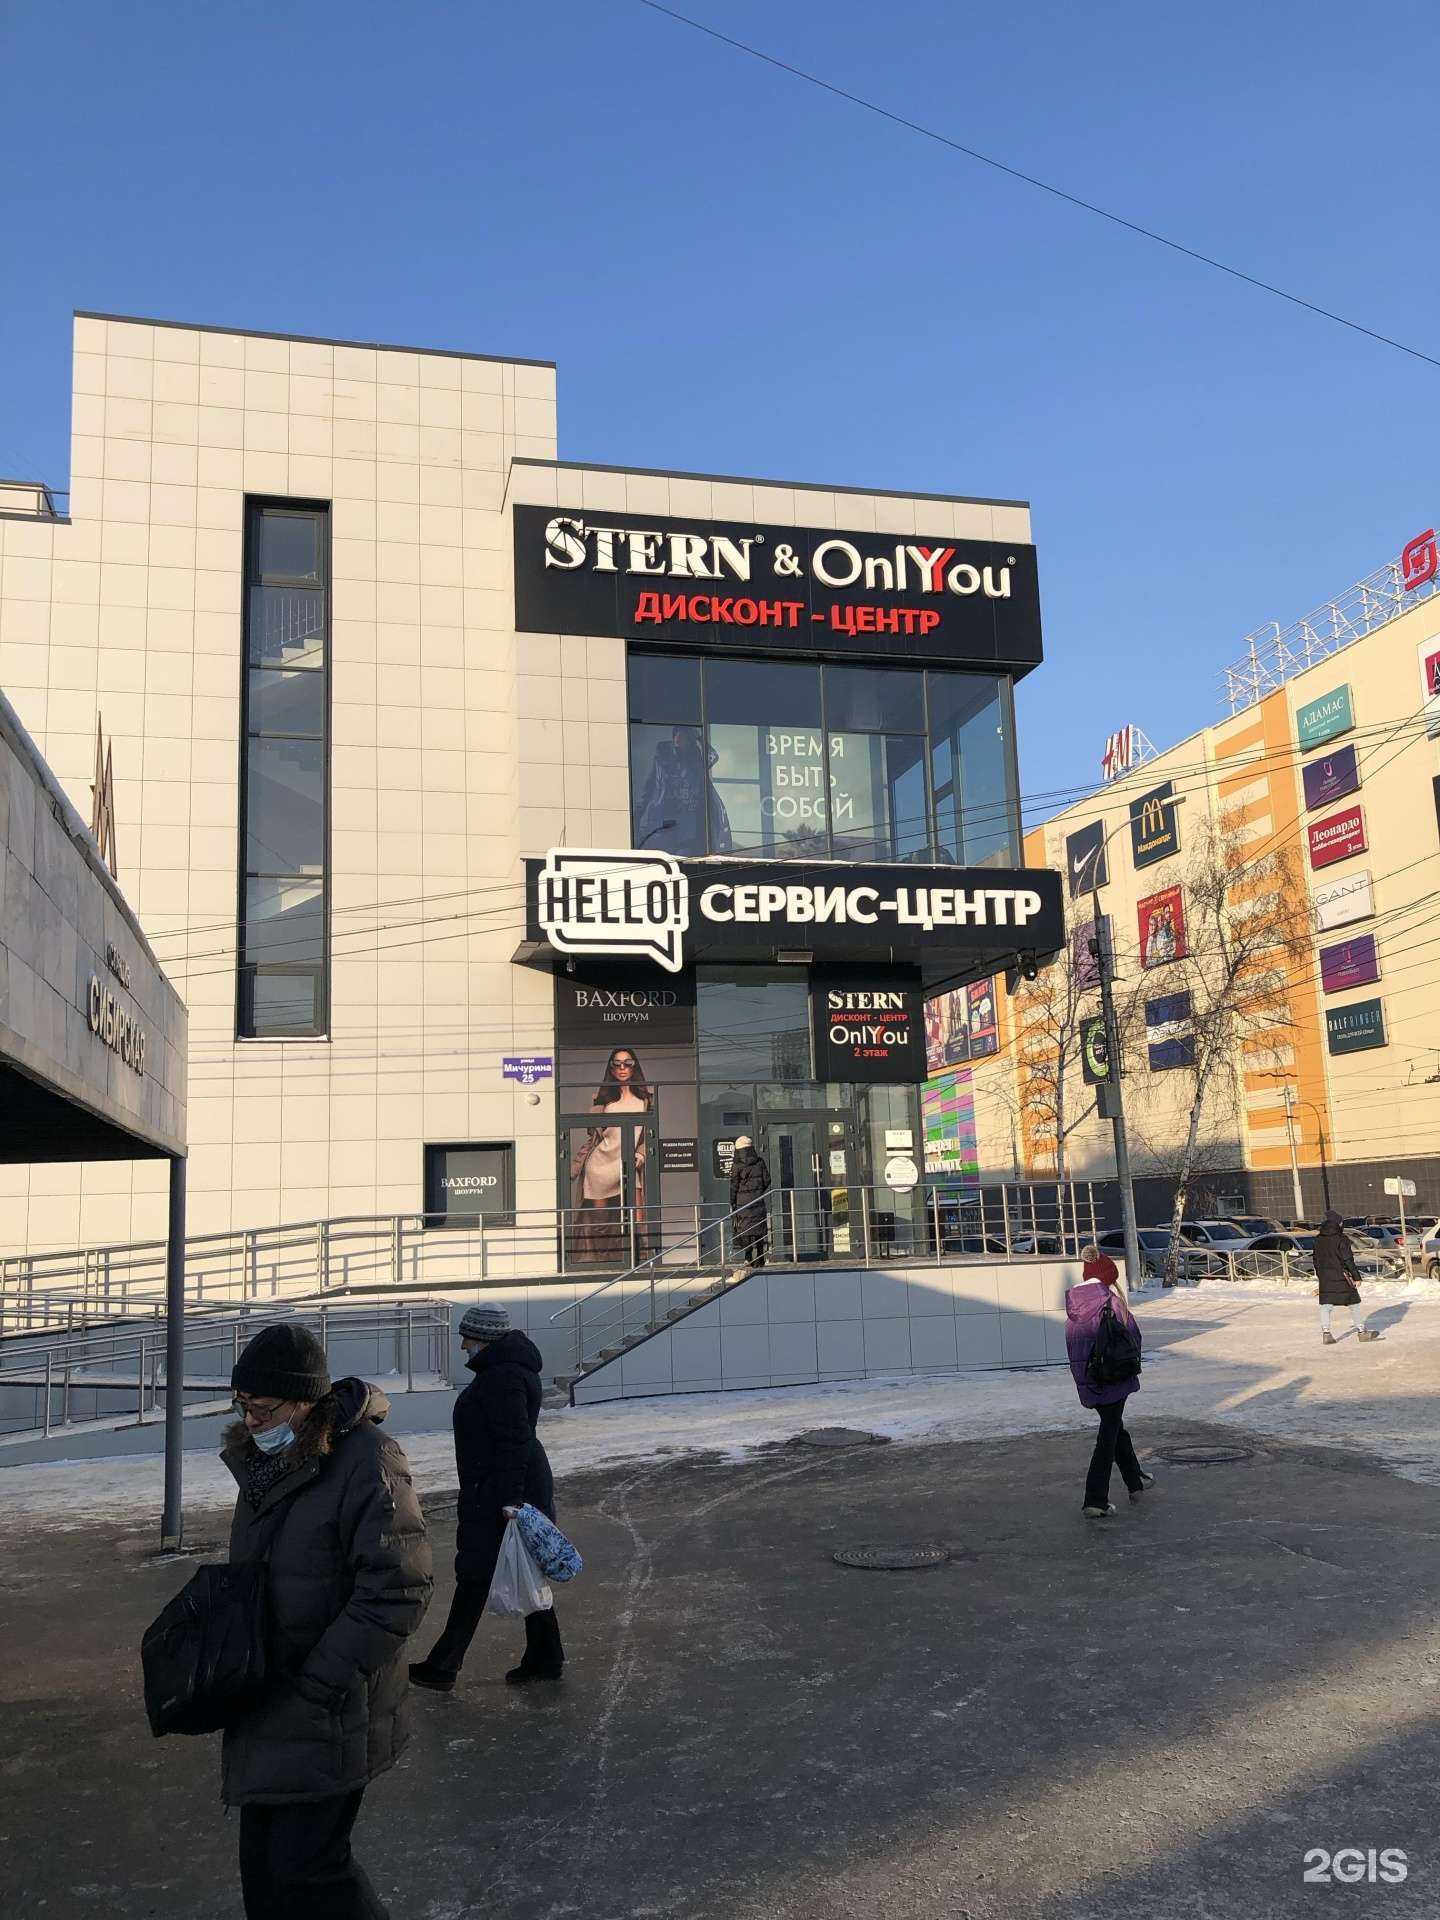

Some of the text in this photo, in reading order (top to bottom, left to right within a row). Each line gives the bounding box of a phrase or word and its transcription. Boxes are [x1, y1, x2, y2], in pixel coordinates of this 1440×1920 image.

[545, 516, 754, 581] STERN
[774, 543, 803, 577] &
[635, 591, 804, 627] ДИСКОНТ
[831, 604, 940, 636] ЦЕНТР
[1303, 697, 1344, 728] АДАМАС
[765, 735, 844, 757] ВРЕМЯ
[1312, 817, 1360, 843] Леонардо
[546, 877, 681, 926] HELLO!
[1316, 879, 1367, 905] GANT
[700, 884, 1042, 931] СЕРВИС-ЦЕНТР
[575, 990, 677, 1007] BAXFORD
[828, 989, 905, 1009] STERN
[603, 1013, 649, 1023] ШОУРУМ
[831, 1013, 872, 1022] ДИСКОНТ
[879, 1014, 908, 1023] ЦЕНТР
[854, 1047, 889, 1057] 2 этаж
[504, 1063, 552, 1074] Мичурина
[522, 1073, 535, 1083] 25
[441, 1175, 497, 1188] BAXFORD
